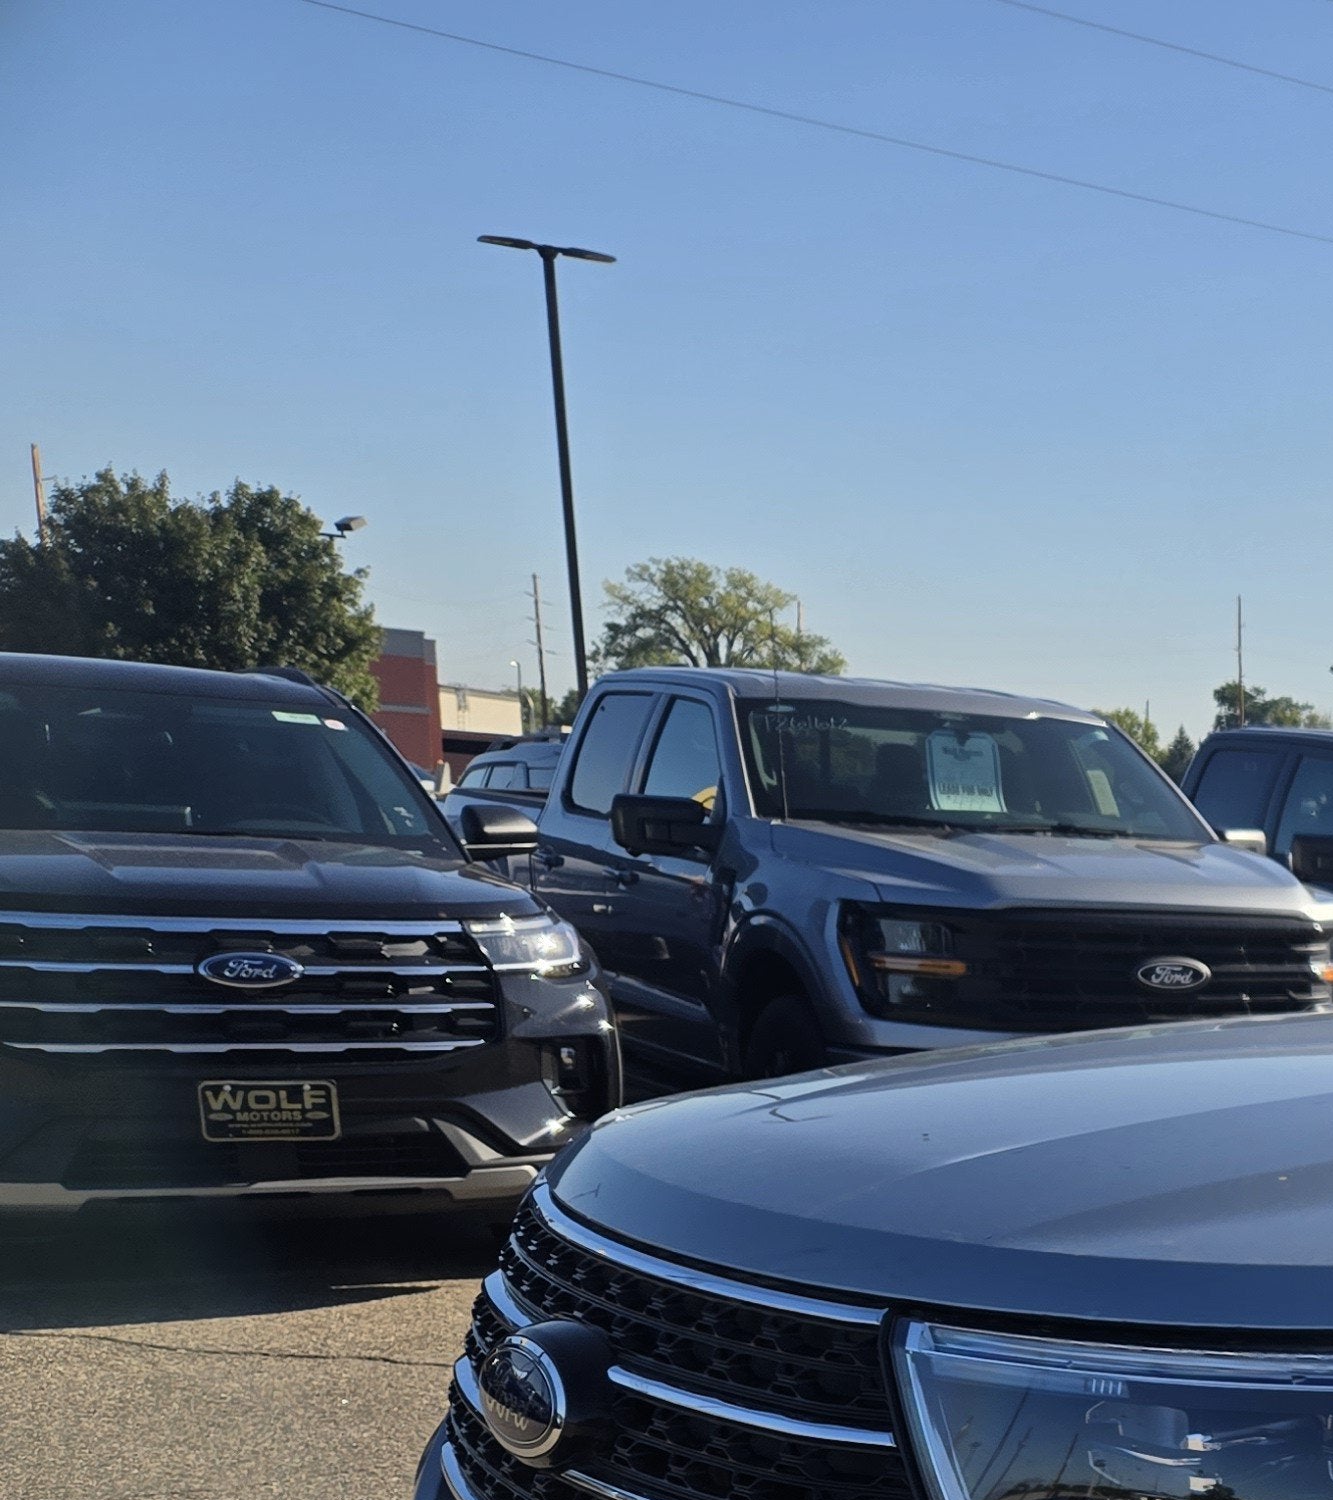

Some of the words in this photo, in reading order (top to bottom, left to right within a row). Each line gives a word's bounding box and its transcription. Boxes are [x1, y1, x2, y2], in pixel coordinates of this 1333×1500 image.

[224, 960, 278, 978] Ford
[1151, 966, 1194, 984] Ford
[205, 1089, 326, 1111] WOLF
[235, 1111, 303, 1121] MOTORS
